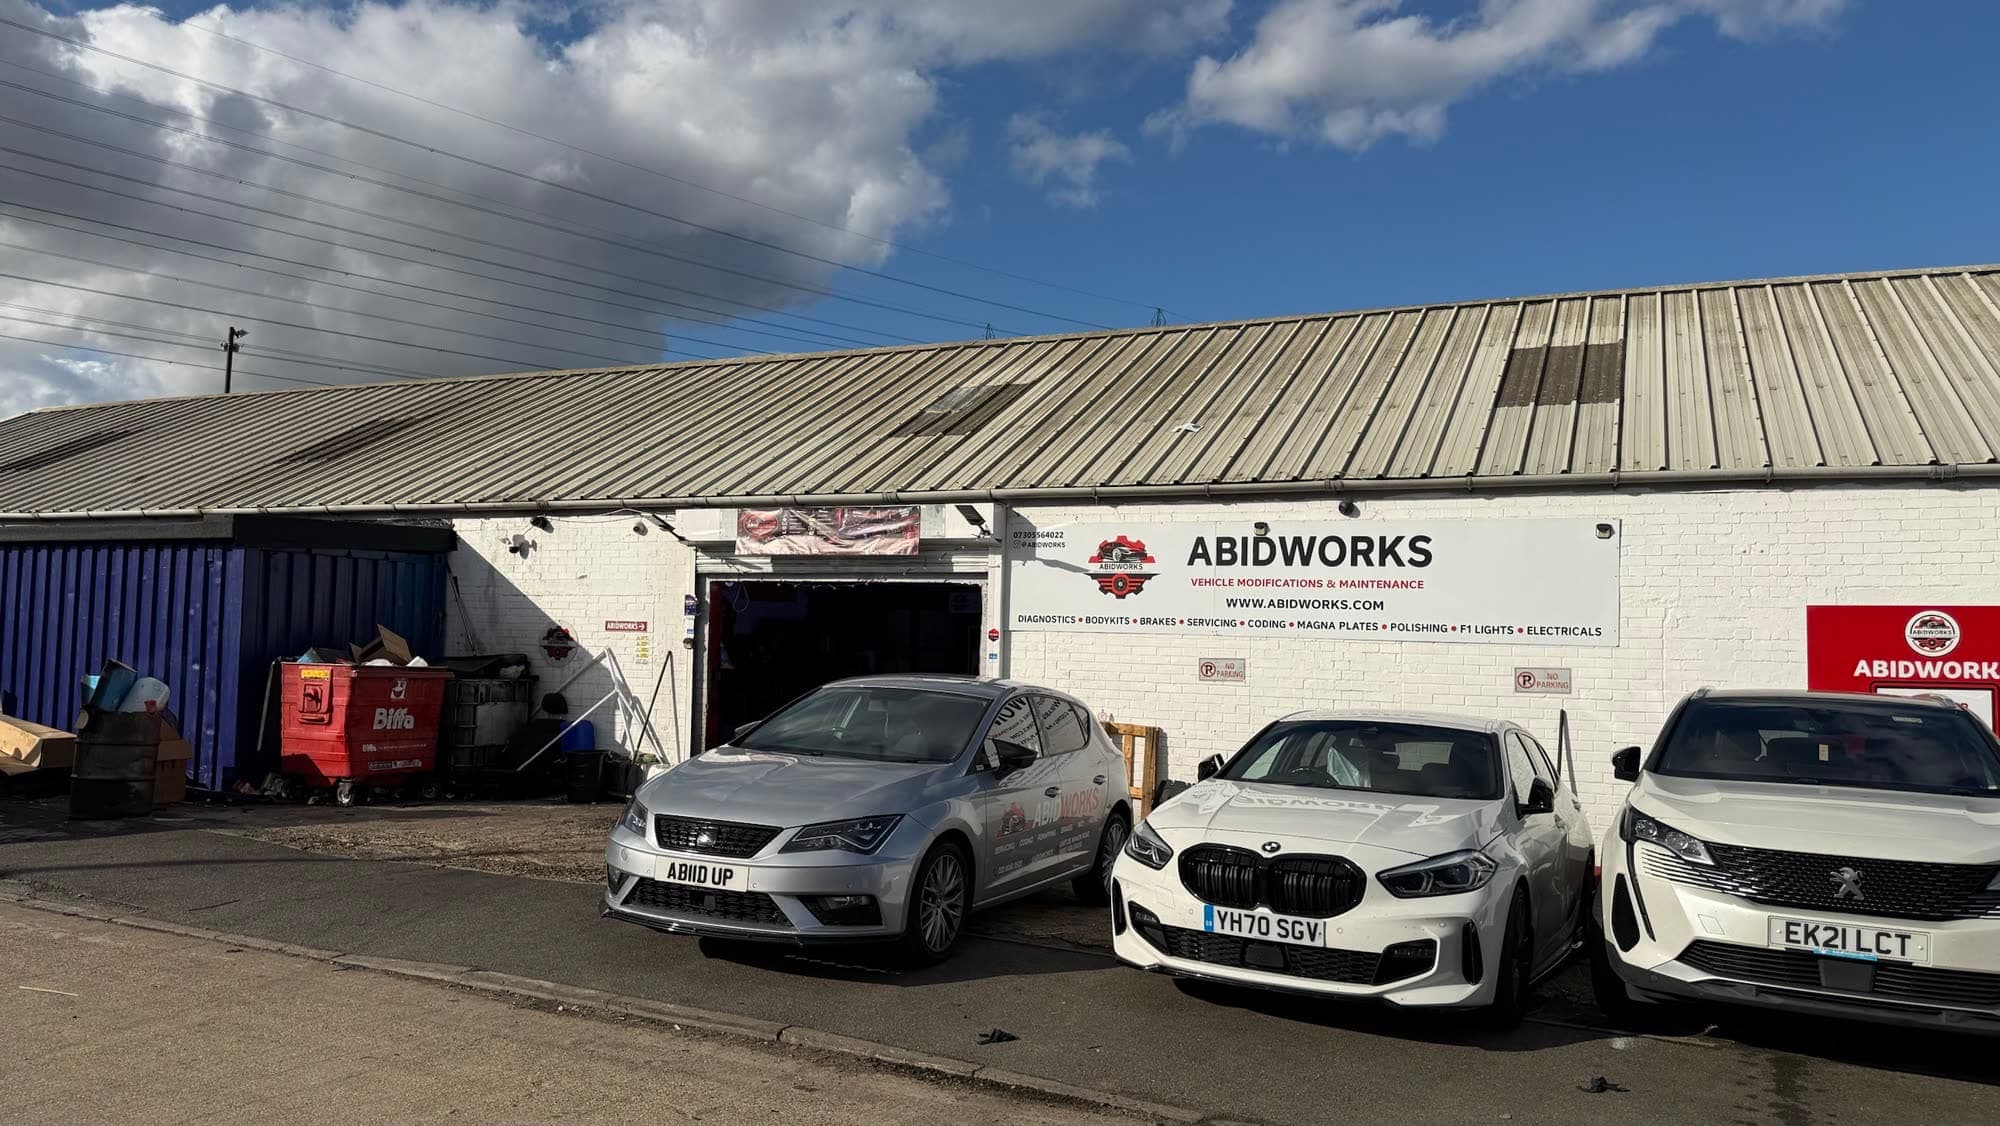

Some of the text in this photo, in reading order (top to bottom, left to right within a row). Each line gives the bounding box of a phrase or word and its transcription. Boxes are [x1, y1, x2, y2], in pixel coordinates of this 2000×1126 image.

[1013, 531, 1064, 539] 07305564022
[1187, 535, 1434, 568] ABIDWORKS
[1099, 563, 1144, 571] ABIDWORKS
[1191, 577, 1425, 590] VEHICLE MODIFICATIONS & MAINTENANCE
[1226, 597, 1384, 611] WWW.ABIDWORKS.COM
[1018, 614, 1603, 638] DIAGNOSTICS BODYKITS BRAKES SERVICING CODING MAGNA PLATES POLISHING F1 LIGHTS ELECTRICALS
[1225, 662, 1235, 670] NO
[1217, 670, 1244, 678] PARKING
[1546, 672, 1559, 681] NO
[1536, 681, 1569, 689] PARKING
[373, 707, 415, 730] Biffa
[711, 866, 733, 887] UP
[1216, 909, 1320, 943] YH70 SGV
[1785, 921, 1912, 956] EK21 LCT
